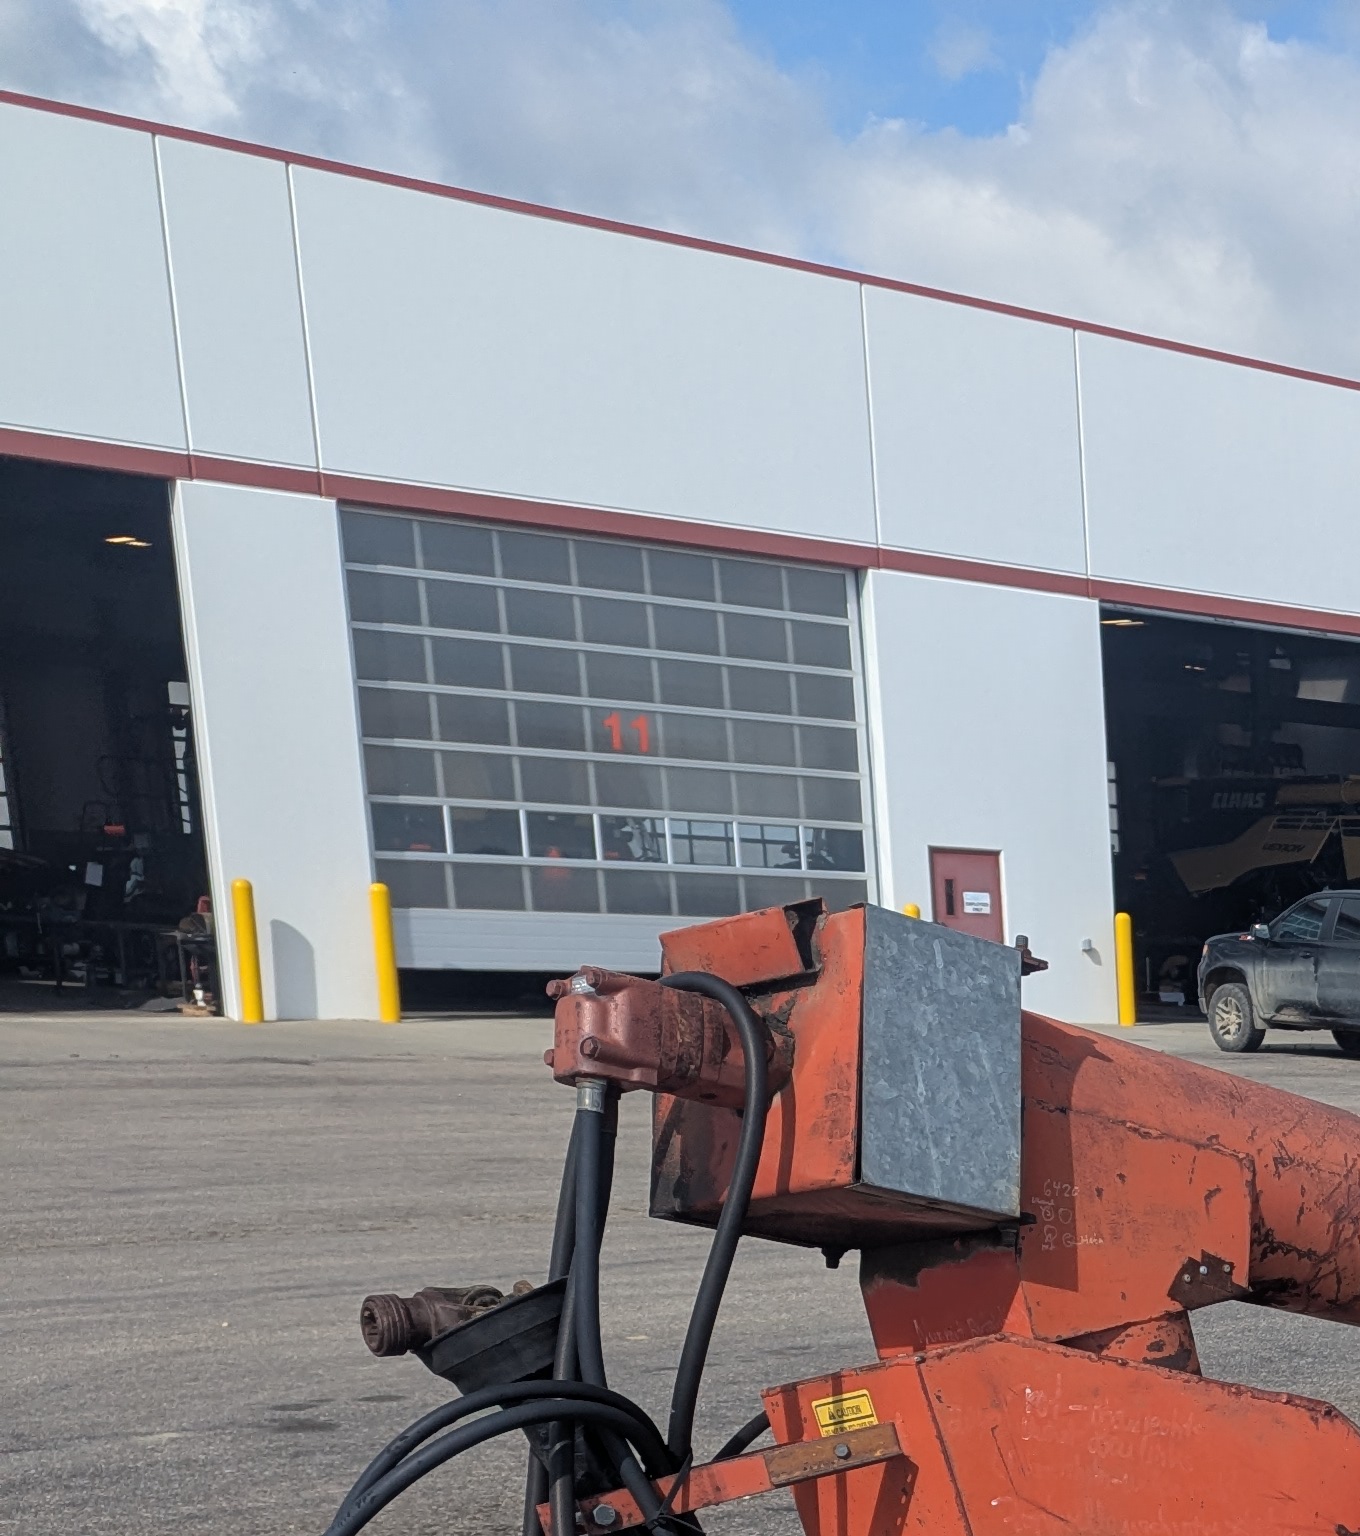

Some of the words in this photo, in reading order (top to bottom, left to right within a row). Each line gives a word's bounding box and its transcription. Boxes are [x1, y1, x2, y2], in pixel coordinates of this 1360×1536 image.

[602, 710, 649, 753] 11
[1211, 792, 1266, 809] CLAAS
[1043, 1179, 1080, 1197] 6420
[836, 1405, 862, 1419] CAUTION
